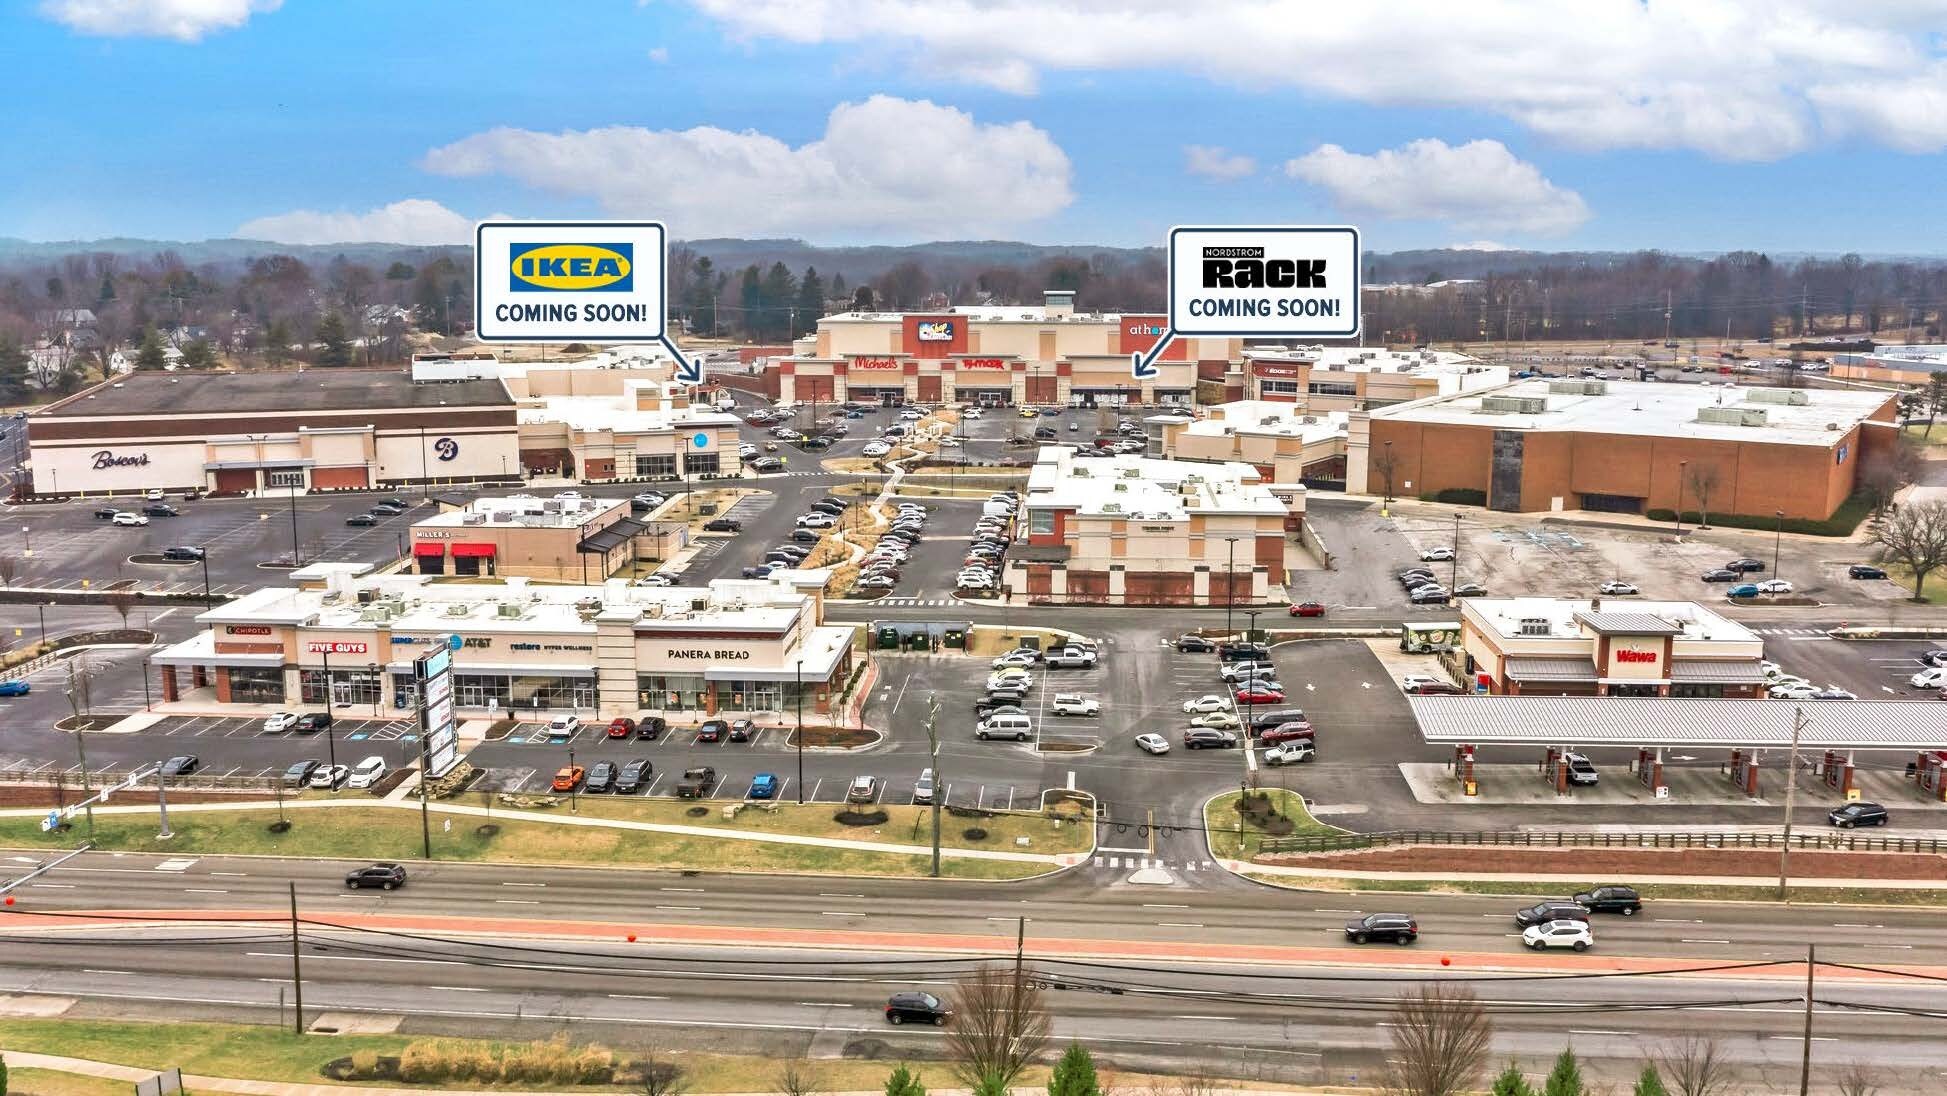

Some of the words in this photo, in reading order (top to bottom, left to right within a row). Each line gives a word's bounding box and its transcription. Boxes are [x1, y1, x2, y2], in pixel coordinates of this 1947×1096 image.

[309, 643, 333, 652] FIVE
[335, 643, 365, 652] GUYS
[464, 638, 492, 648] AT&T
[668, 650, 711, 659] PANERA
[714, 651, 749, 660] BREAD
[1616, 650, 1657, 663] Wawa
